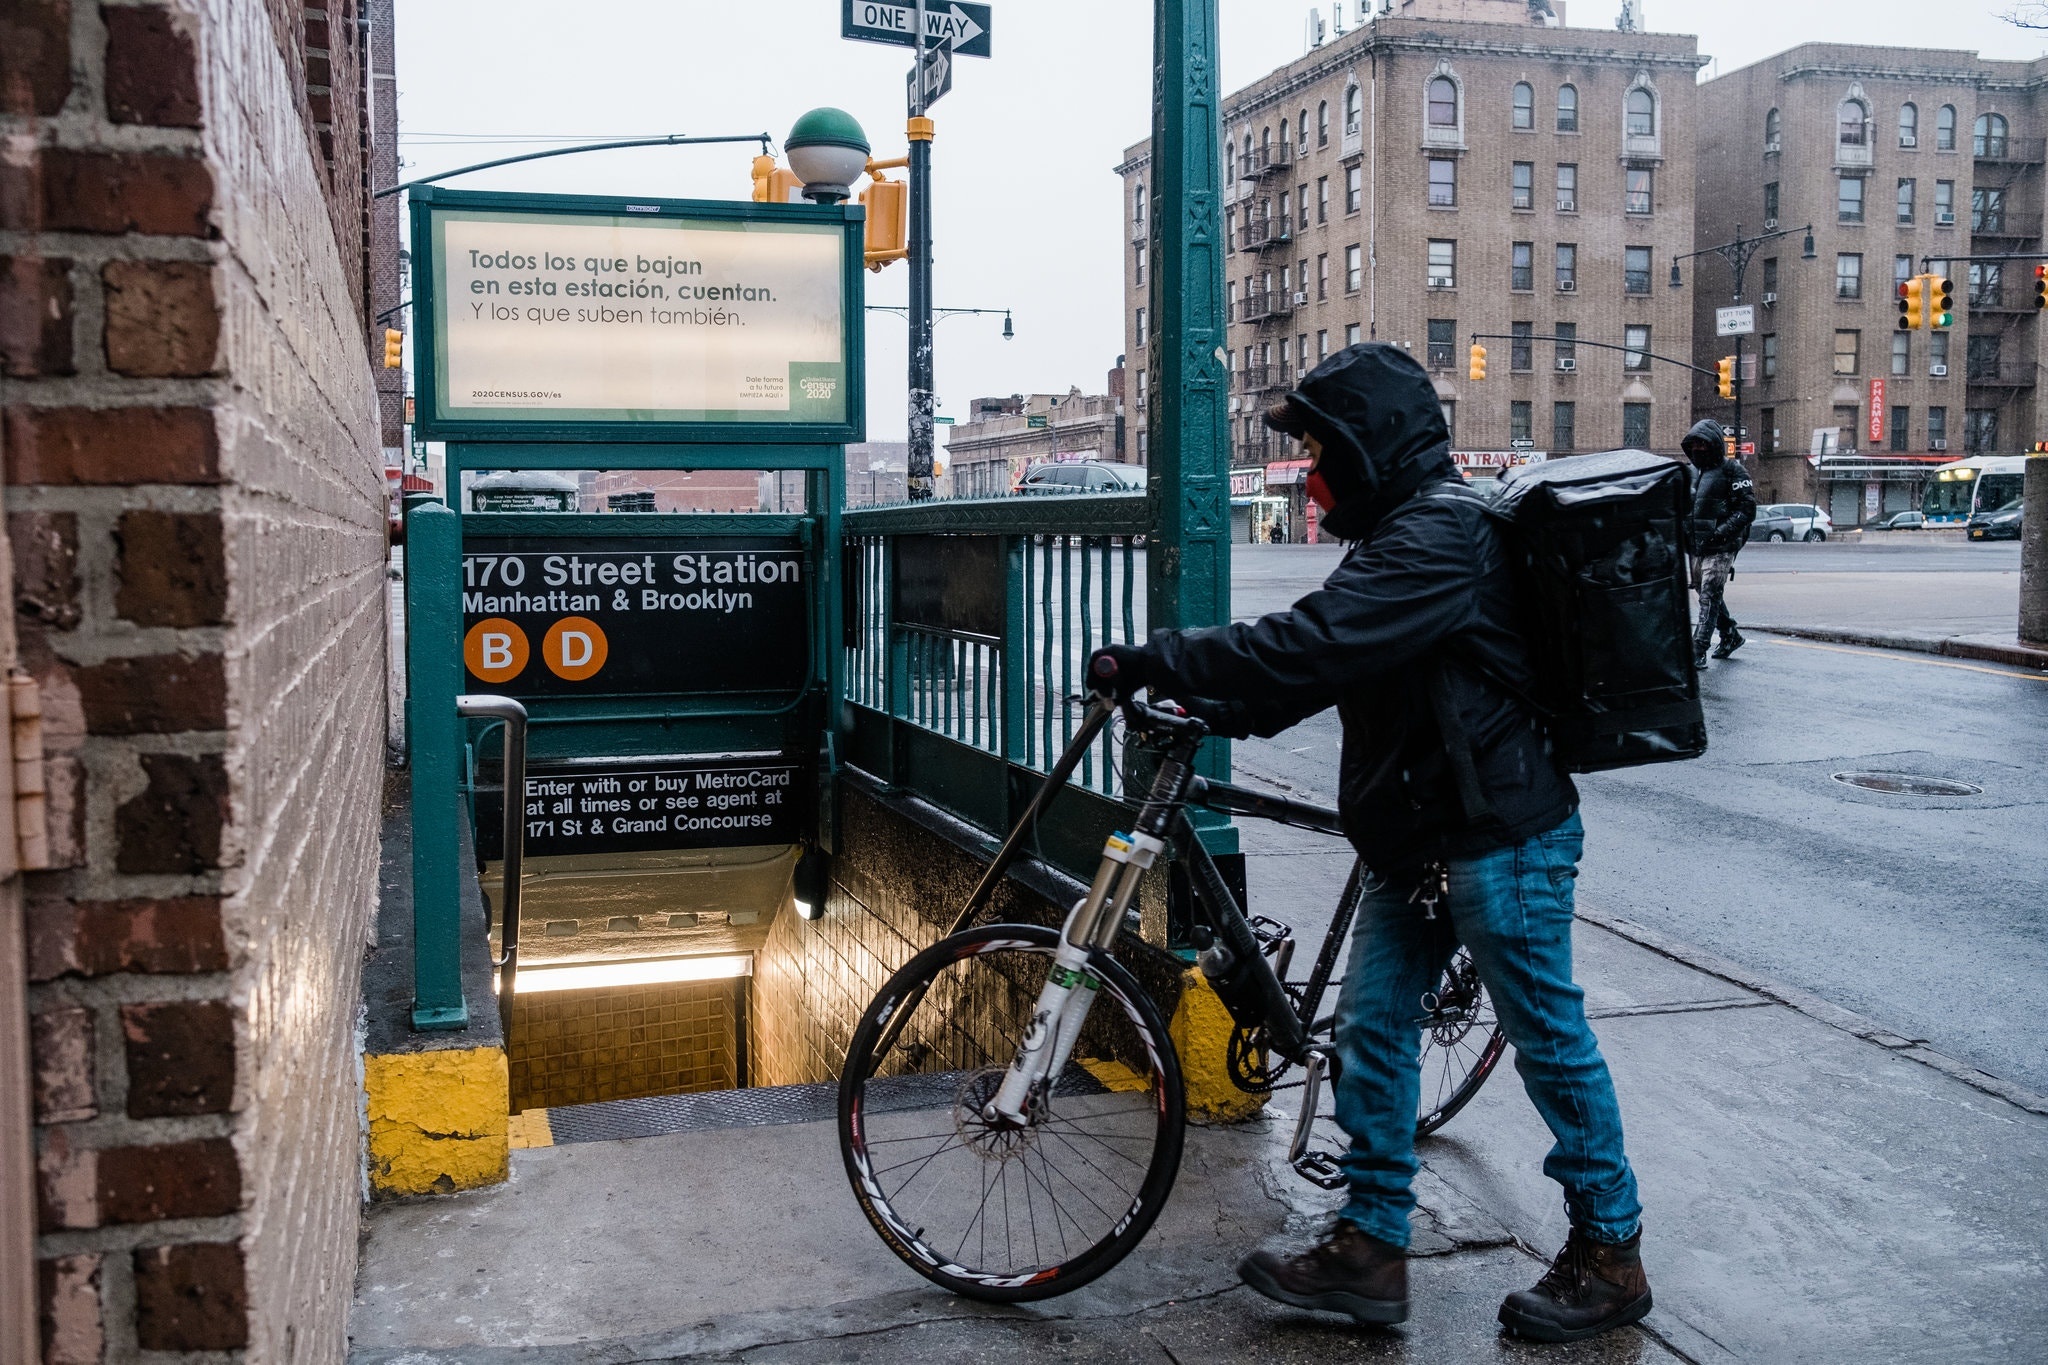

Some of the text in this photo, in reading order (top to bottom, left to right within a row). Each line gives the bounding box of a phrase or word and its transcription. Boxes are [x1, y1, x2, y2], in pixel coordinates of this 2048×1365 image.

[865, 5, 969, 38] ONE WAY
[929, 60, 945, 88] WAY
[469, 250, 702, 278] Todos los que bajan
[470, 277, 777, 302] en esta estación, cuentan.
[471, 302, 746, 326] Y los que suben también.
[472, 391, 562, 399] 2020CENSUS.GOV/es
[800, 378, 836, 390] Census
[807, 389, 831, 399] 2020
[1872, 381, 1882, 438] PHARMACY
[1231, 474, 1254, 494] DELI
[1732, 480, 1752, 490] DKN
[462, 554, 800, 587] 170 Street Station
[463, 588, 753, 613] Manhattan & Brooklyn
[482, 631, 593, 668] B D
[525, 770, 790, 797] Enter with or buy MetroCard
[526, 789, 782, 815] at all times or see agent at
[526, 813, 772, 837] 171 St & Grand Concourse
